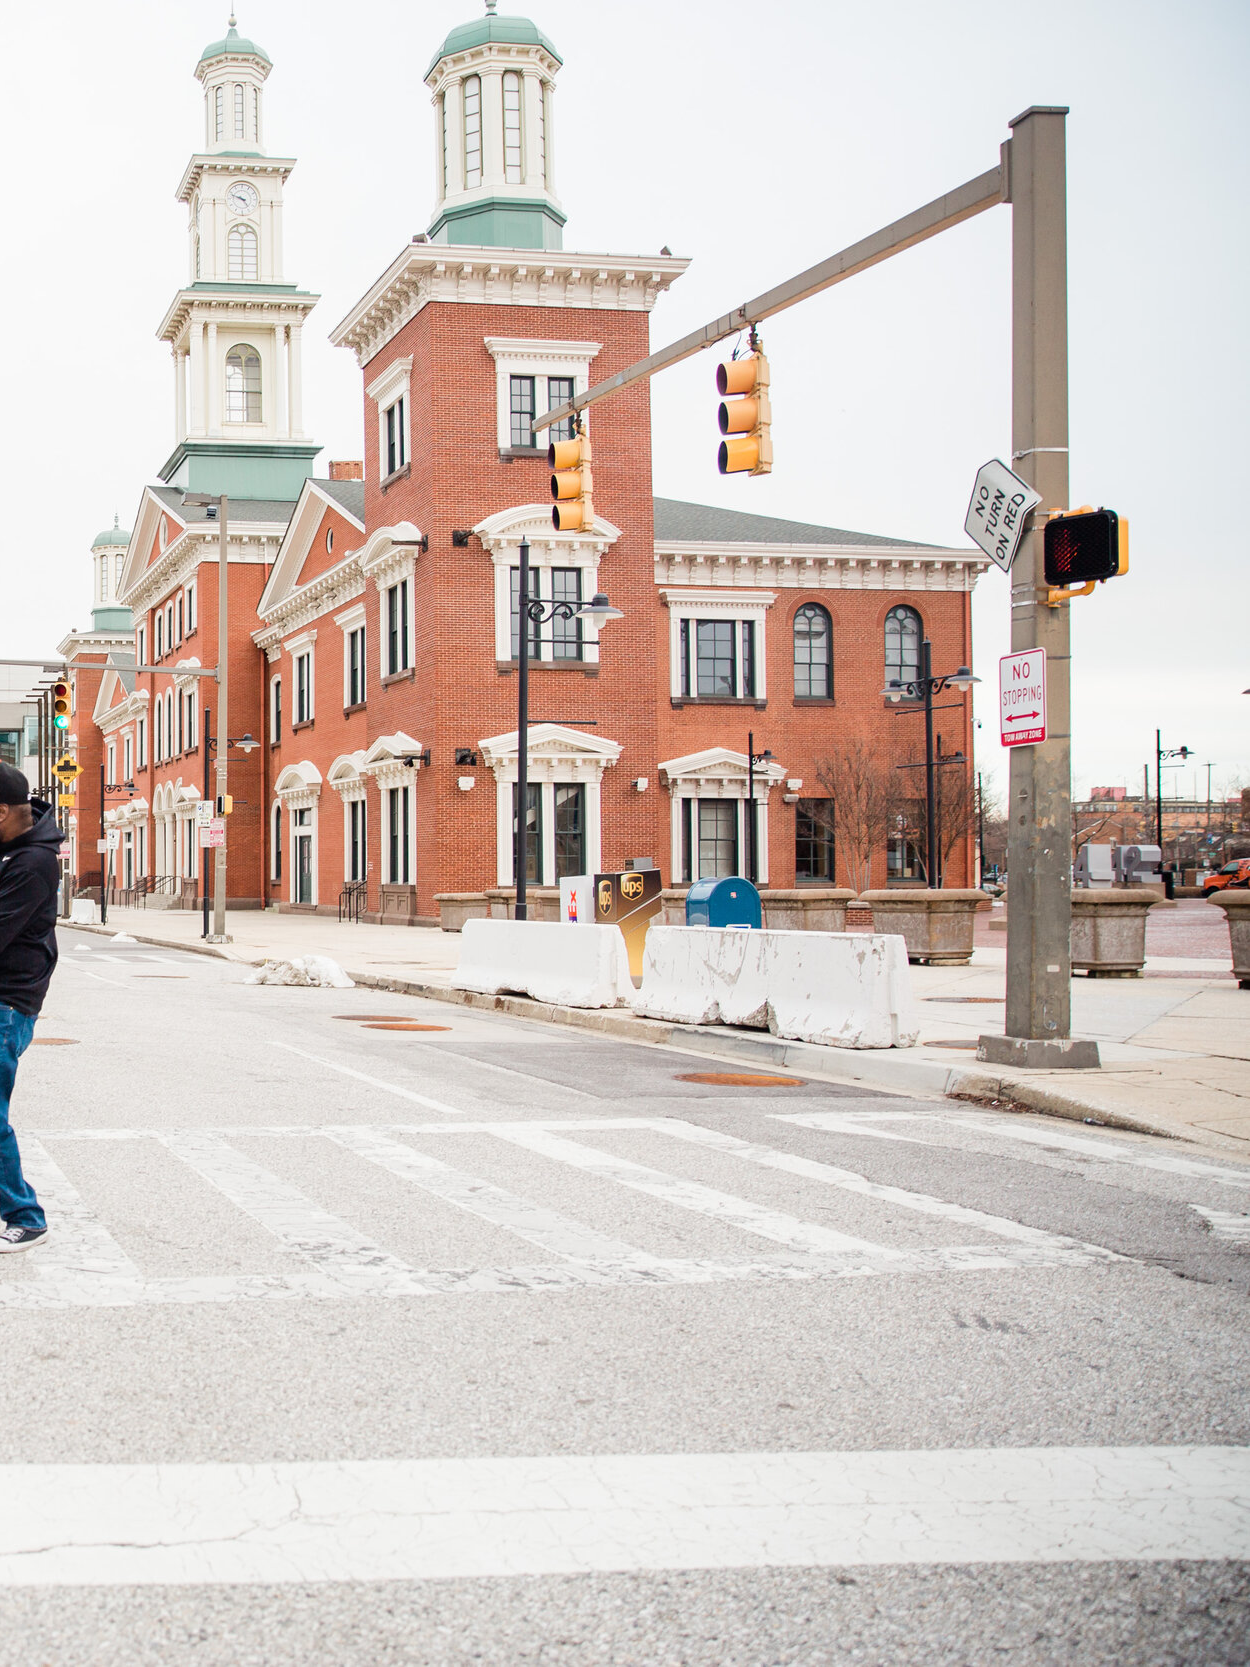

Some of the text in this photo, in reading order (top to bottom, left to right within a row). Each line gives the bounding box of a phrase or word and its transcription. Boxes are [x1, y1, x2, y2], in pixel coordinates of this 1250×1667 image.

[975, 486, 989, 518] NO
[985, 488, 1006, 537] TURN
[995, 493, 1026, 560] ON RED
[1012, 662, 1030, 681] NO
[1002, 685, 1042, 706] STOPPING
[1004, 733, 1015, 742] TOW
[1028, 729, 1042, 739] ZONE
[623, 881, 643, 897] ups
[599, 891, 612, 910] ups
